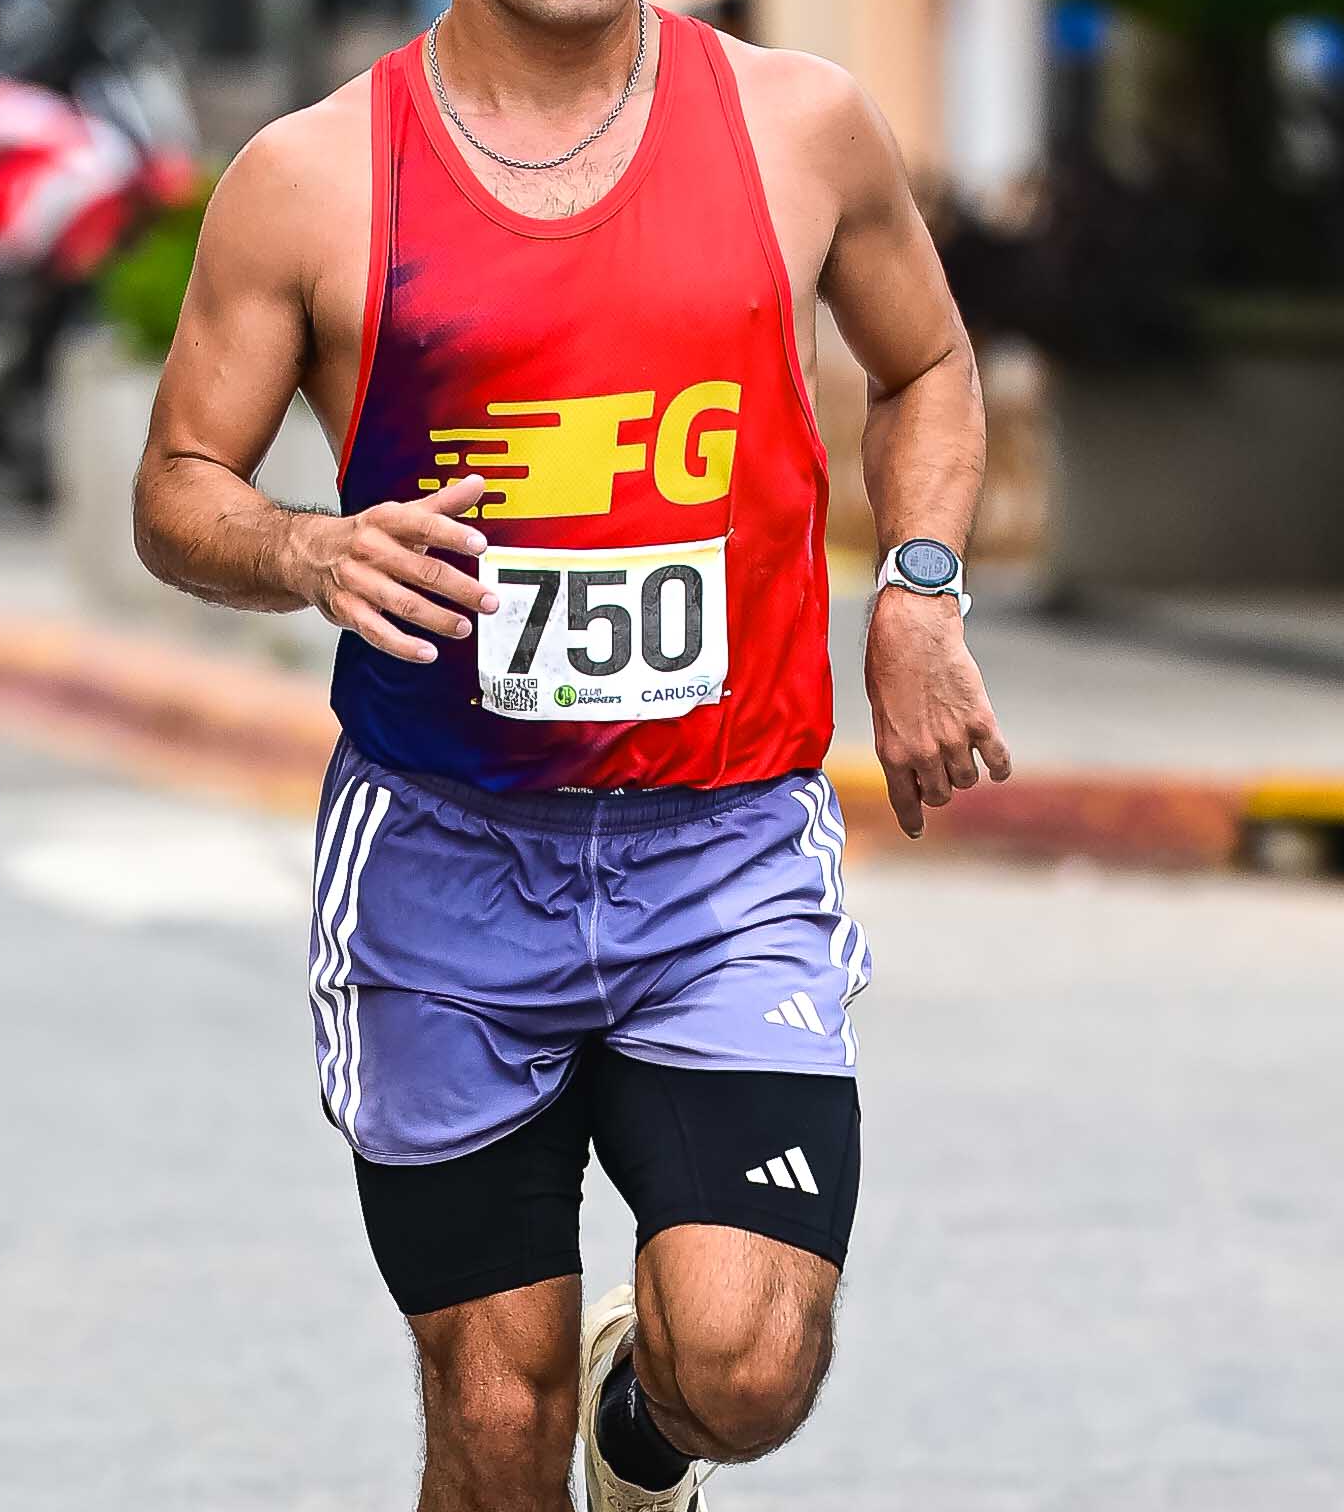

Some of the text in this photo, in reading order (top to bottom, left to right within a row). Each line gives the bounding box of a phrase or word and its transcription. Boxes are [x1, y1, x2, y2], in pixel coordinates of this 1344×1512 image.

[420, 381, 742, 519] FG
[498, 564, 703, 676] 750
[641, 684, 707, 703] CARUSO
